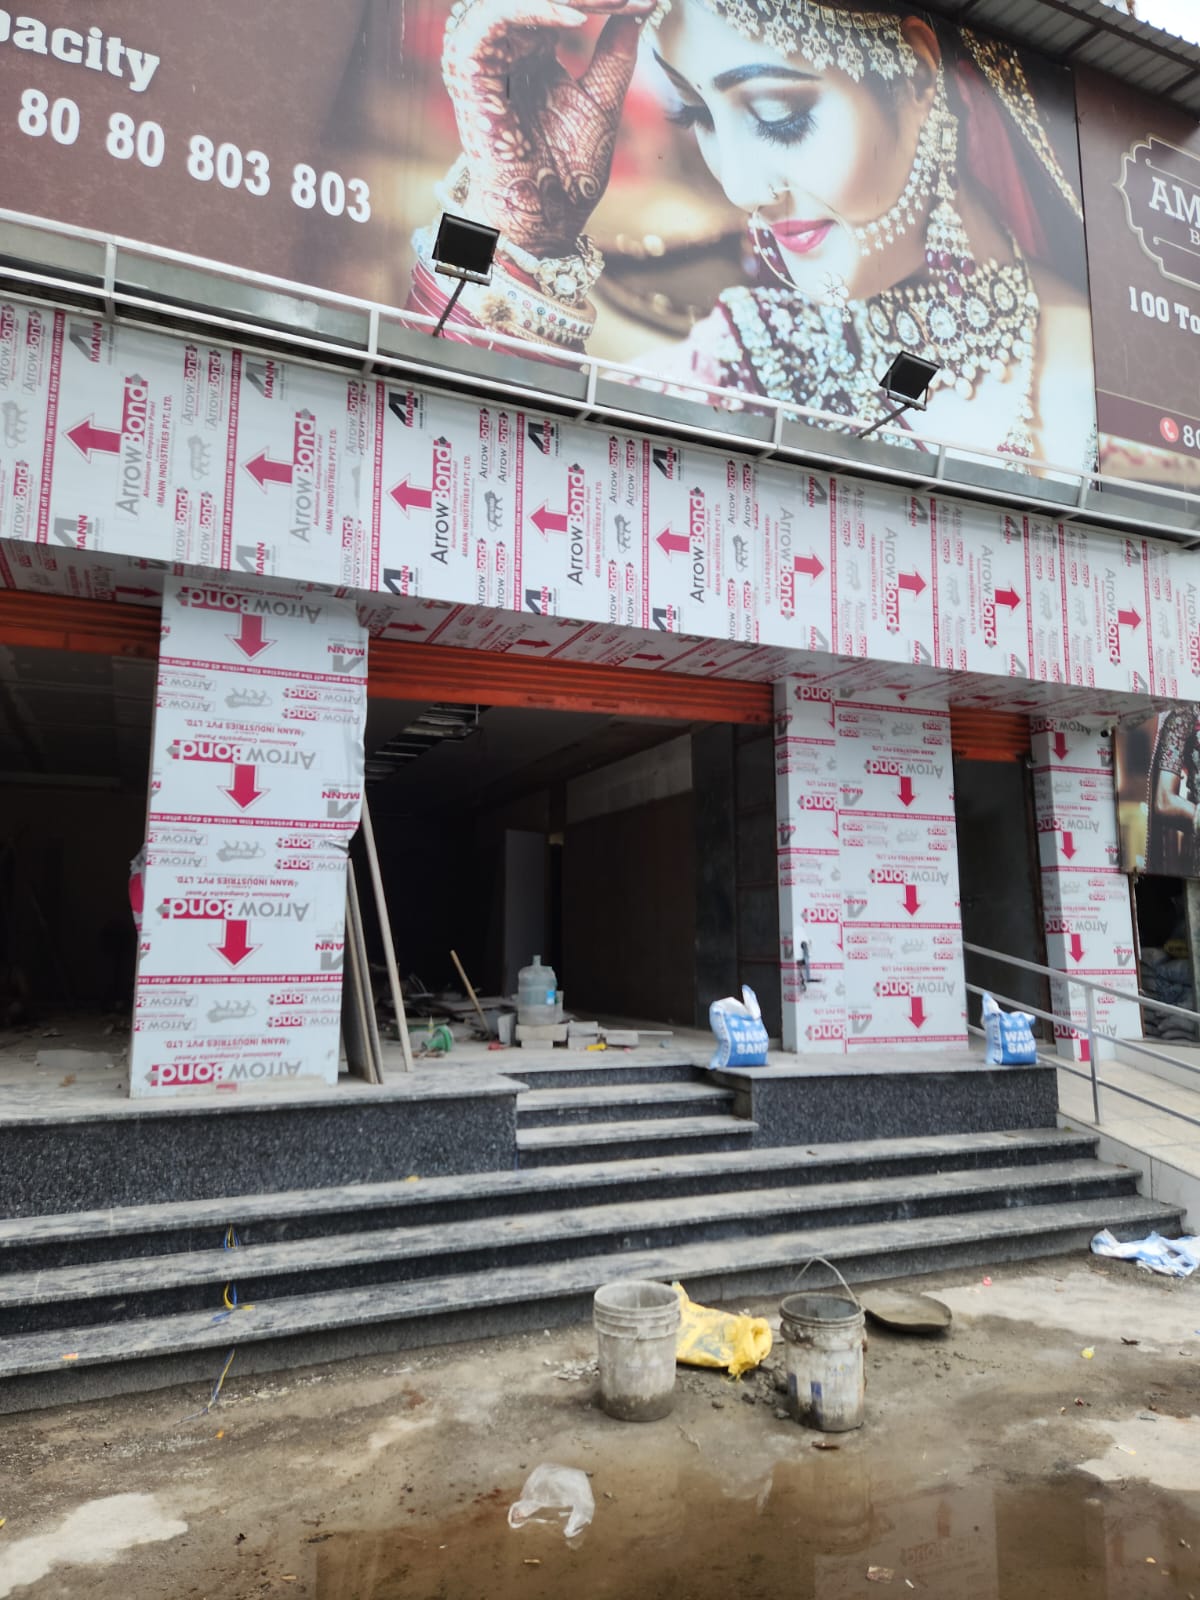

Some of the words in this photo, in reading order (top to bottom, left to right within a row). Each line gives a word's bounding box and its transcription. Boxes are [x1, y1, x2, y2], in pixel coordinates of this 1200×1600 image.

[18, 88, 80, 145] 80
[106, 112, 165, 167] 80
[187, 135, 270, 196] 803
[291, 163, 371, 223] 803
[1149, 176, 1200, 228] AM
[1129, 286, 1169, 322] 100
